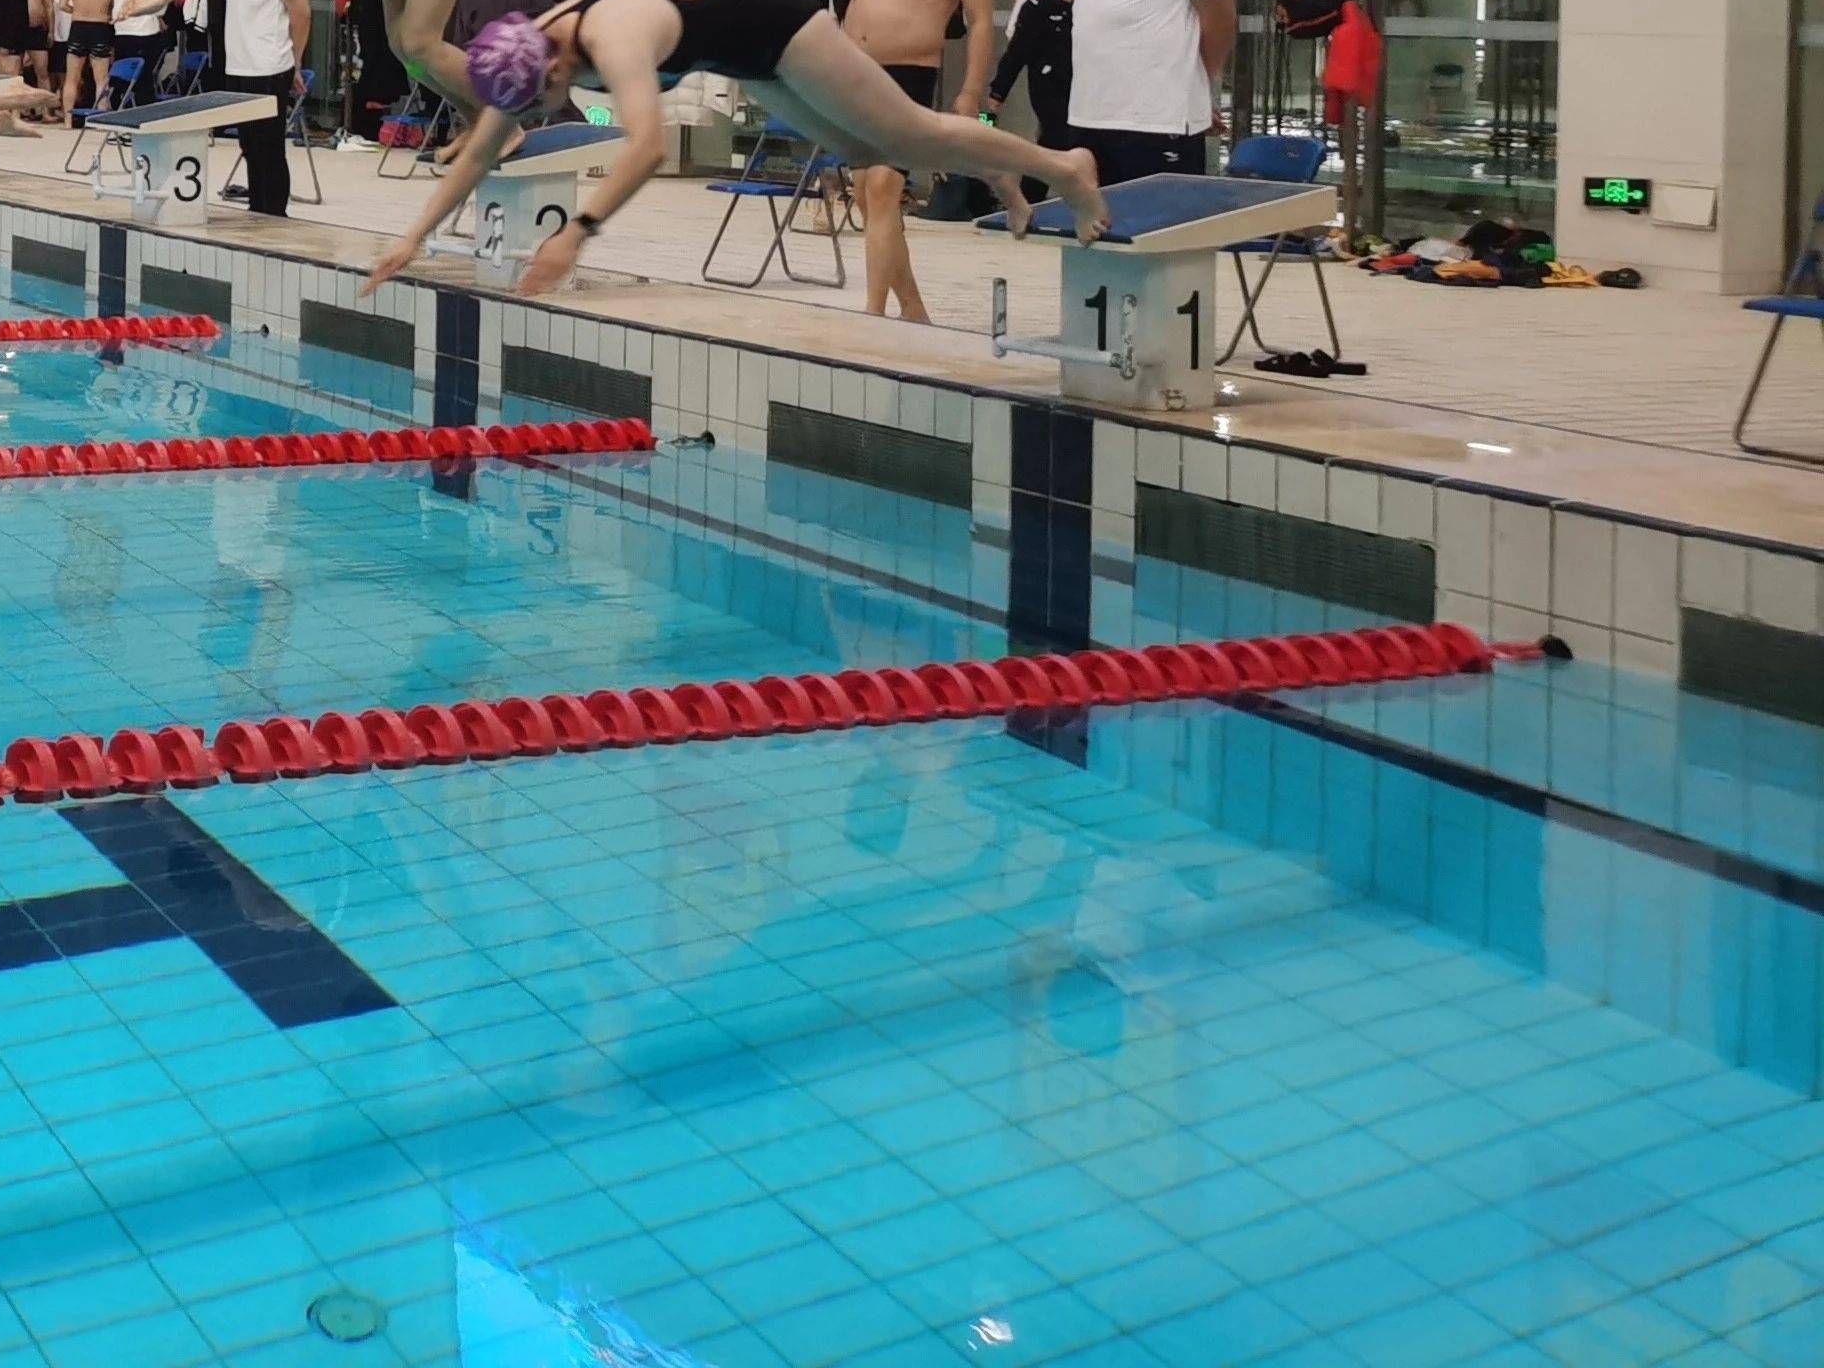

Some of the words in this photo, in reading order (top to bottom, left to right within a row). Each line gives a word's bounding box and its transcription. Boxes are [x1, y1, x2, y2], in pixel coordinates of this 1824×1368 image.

[173, 156, 202, 202] 3
[1084, 285, 1107, 351] 1
[1177, 289, 1200, 370] 1
